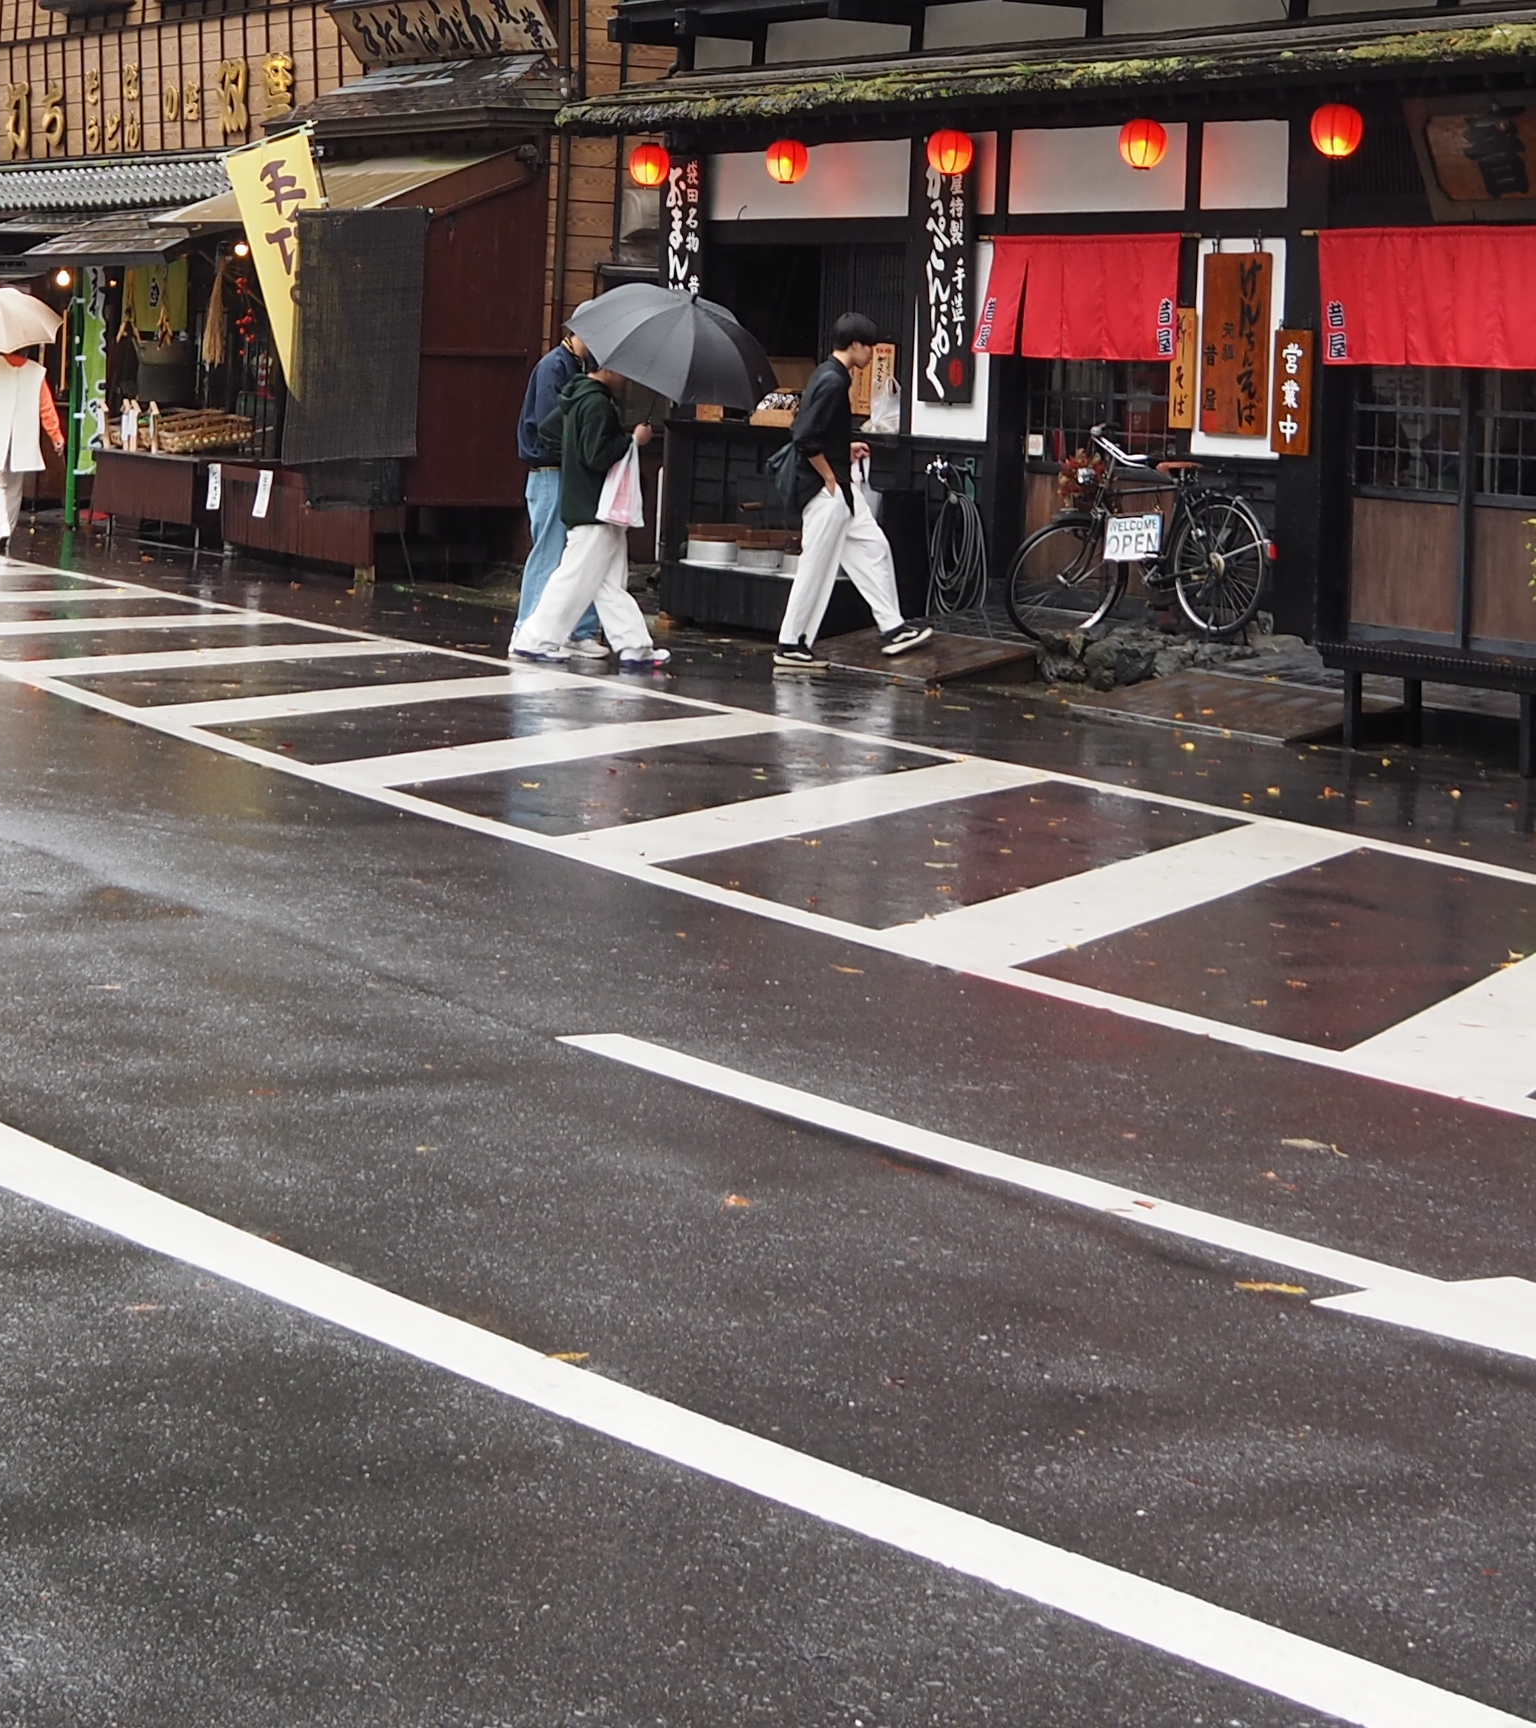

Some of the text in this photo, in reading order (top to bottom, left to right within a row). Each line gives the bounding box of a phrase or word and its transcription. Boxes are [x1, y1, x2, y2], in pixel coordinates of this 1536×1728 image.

[86, 109, 141, 151] うどん
[165, 80, 201, 122] の店
[685, 159, 701, 254] 袋田名物
[948, 173, 965, 246] 屋特製
[1157, 298, 1174, 355] 昔屋
[1221, 322, 1235, 361] 元祖
[1236, 258, 1263, 428] けんちんそば
[1326, 300, 1348, 360] 昔屋
[1203, 343, 1218, 412] 昔屋
[1278, 342, 1304, 444] 営業中
[1108, 532, 1158, 555] OPEN
[1109, 518, 1158, 533] WELCOME
